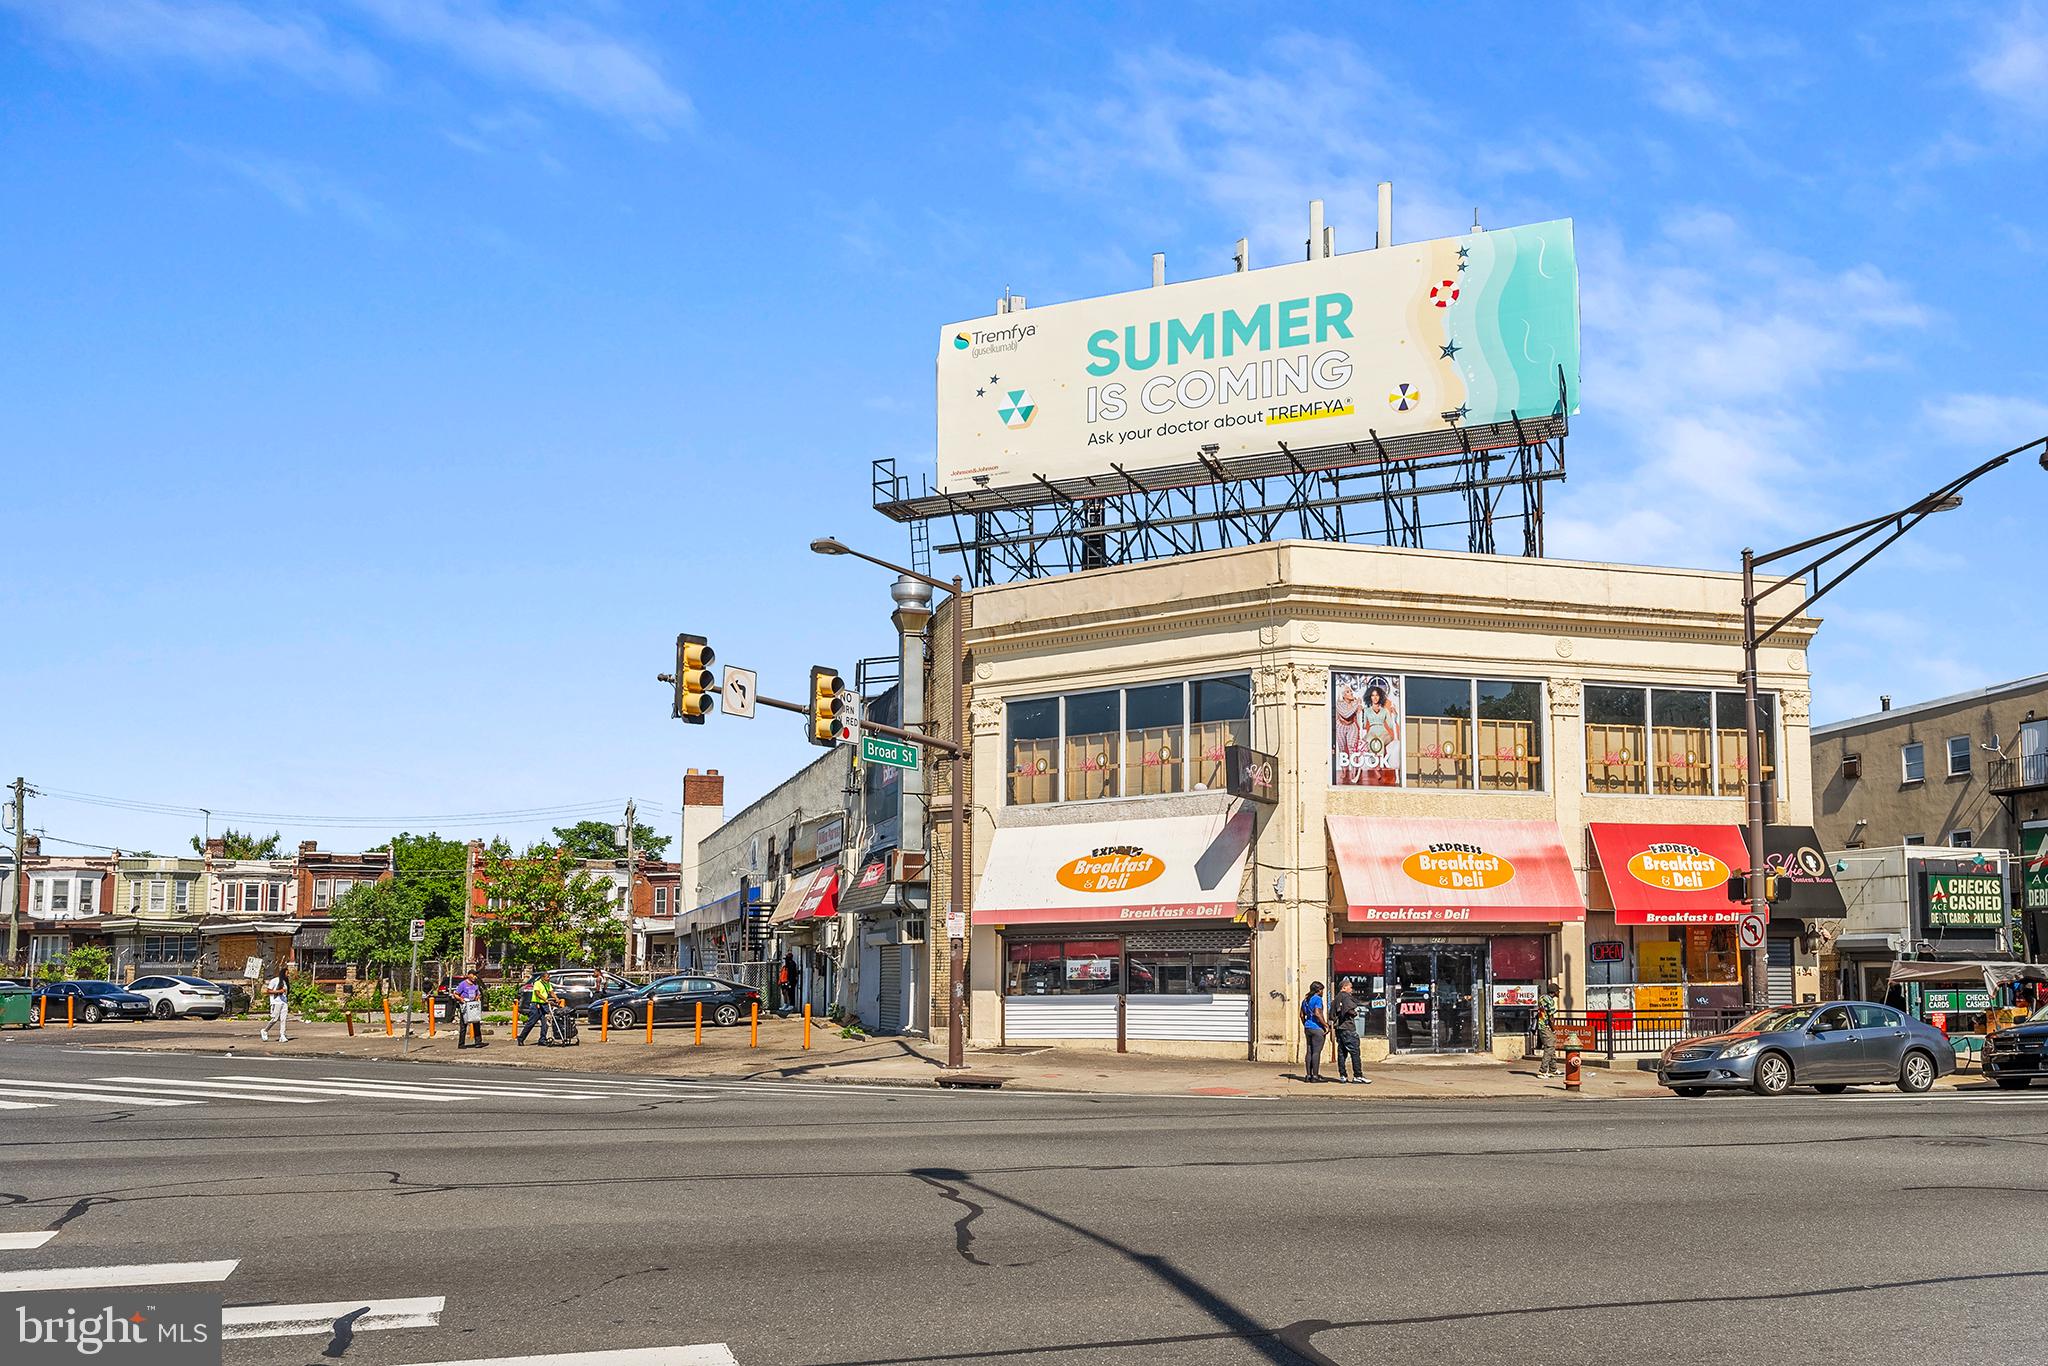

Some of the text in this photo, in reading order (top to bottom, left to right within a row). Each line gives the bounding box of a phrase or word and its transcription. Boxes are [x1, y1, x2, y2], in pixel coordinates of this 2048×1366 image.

[972, 323, 1036, 343] Tremfya
[1085, 292, 1354, 377] SUMMER
[1087, 349, 1353, 424] IS COMING
[1087, 429, 1114, 446] Ask
[1119, 427, 1152, 445] your
[1156, 418, 1210, 436] doctor
[1214, 411, 1264, 429] about
[840, 692, 852, 703] NO
[846, 716, 859, 727] RED
[867, 742, 913, 763] Broad St
[1339, 751, 1391, 769] BOOK
[1428, 842, 1482, 855] EXPRESS
[1650, 844, 1699, 856] EXPRESS
[1073, 857, 1154, 875] Breakfast
[1419, 854, 1499, 871] Breakfast
[1642, 855, 1716, 872] Breakfast
[1083, 873, 1130, 890] & Deli
[1439, 871, 1484, 887] & Deli
[1661, 871, 1703, 887] & Deli
[1791, 876, 1834, 884] Content Room
[2031, 873, 2048, 885] AC
[1948, 879, 2001, 895] CHECKS
[1949, 895, 2001, 911] CASHED
[2028, 888, 2048, 907] DEBI
[1120, 904, 1223, 919] Breakfast & Deli
[1366, 907, 1471, 920] Breakfast & Deli
[1931, 903, 1947, 911] ACE
[1646, 912, 1708, 923] Breakfast
[1715, 912, 1740, 922] Deli
[1949, 912, 1970, 924] CARDS
[1973, 912, 1985, 924] PAY
[1985, 912, 2002, 924] BILLS
[1593, 943, 1623, 961] OPEN
[1069, 965, 1108, 974] SMHIES
[1342, 975, 1367, 984] ATM
[1496, 991, 1535, 999] SMOTHIES
[1399, 1002, 1426, 1015] ATM
[1928, 1000, 1950, 1009] CARDS
[1965, 1000, 1991, 1008] CASHED
